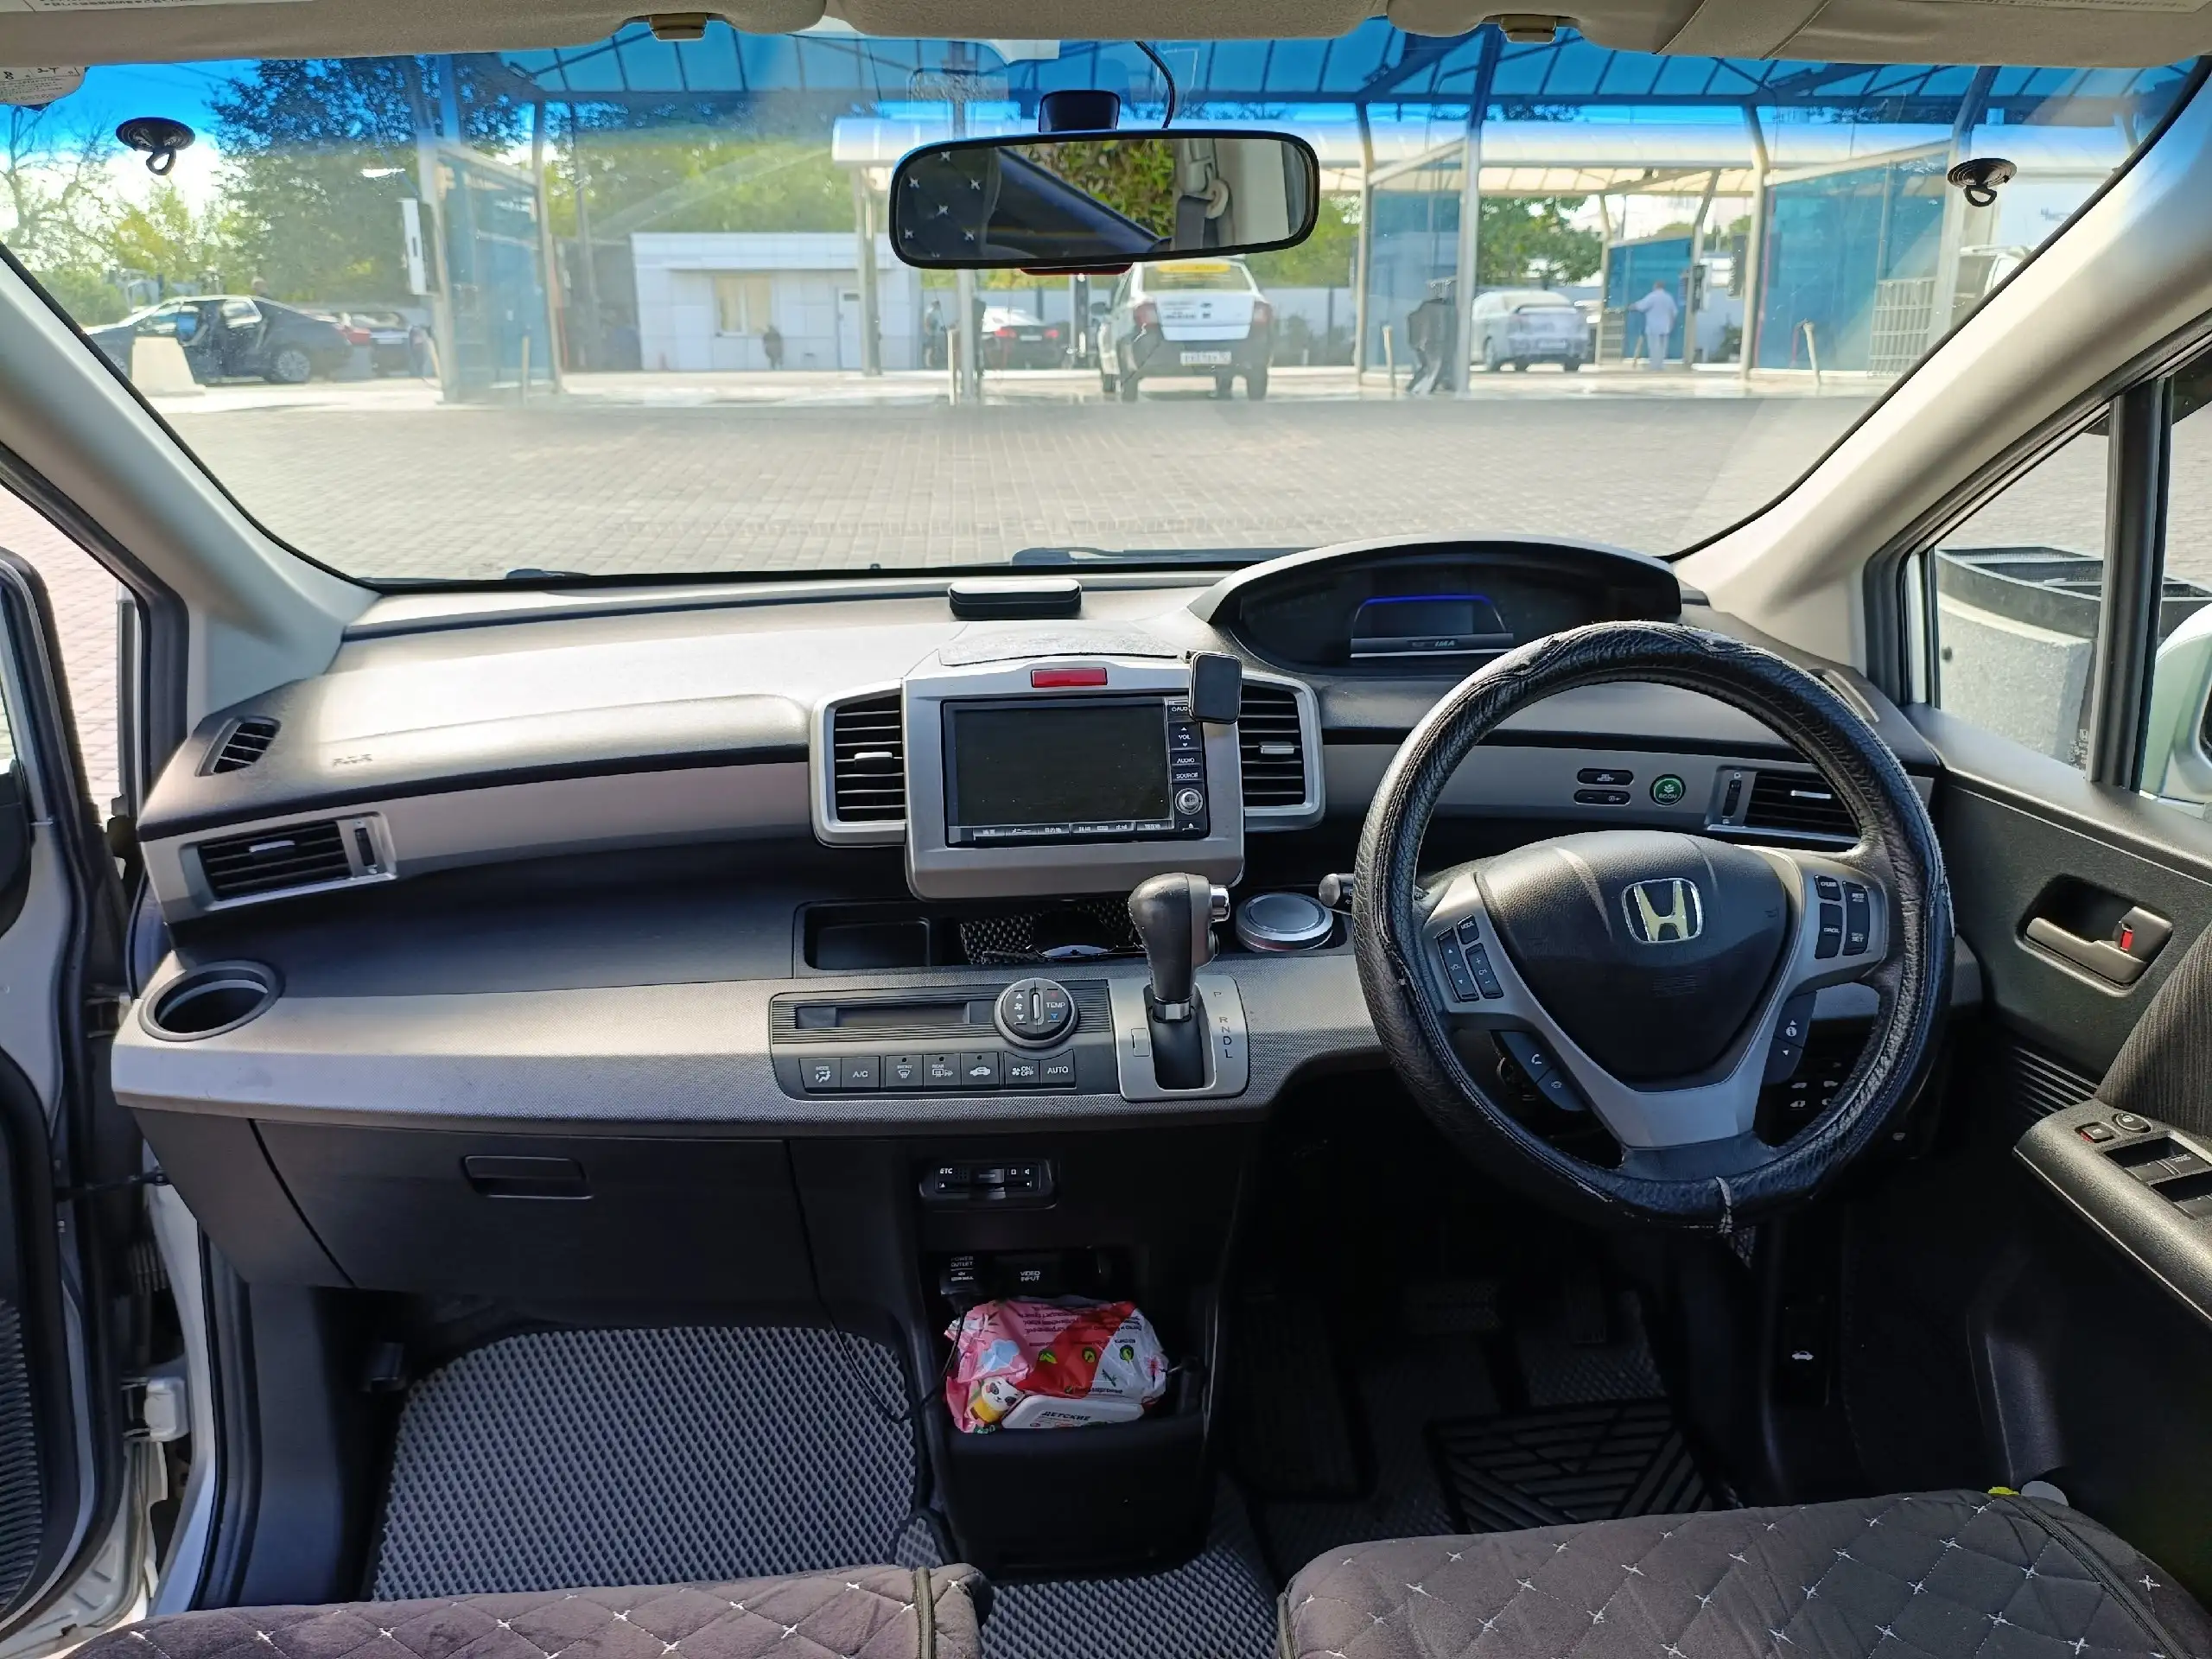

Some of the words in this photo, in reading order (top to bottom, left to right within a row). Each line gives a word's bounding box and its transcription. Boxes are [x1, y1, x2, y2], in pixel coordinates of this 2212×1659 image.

[1223, 1035, 1232, 1046] D
[1224, 1049, 1233, 1058] L
[1046, 1065, 1069, 1075] AUTO
[1042, 1410, 1091, 1421] ДЕТСКИЕ
